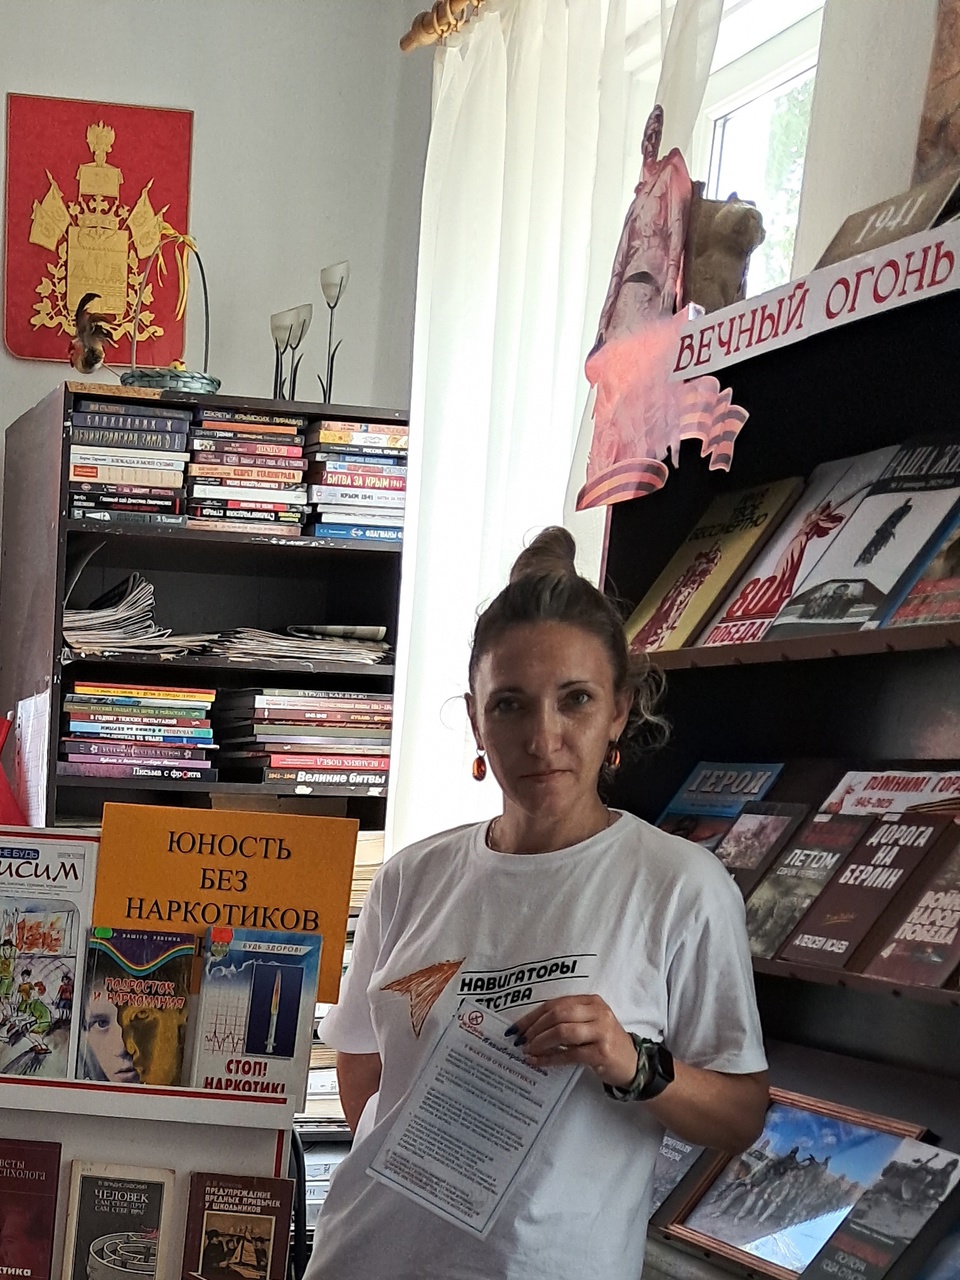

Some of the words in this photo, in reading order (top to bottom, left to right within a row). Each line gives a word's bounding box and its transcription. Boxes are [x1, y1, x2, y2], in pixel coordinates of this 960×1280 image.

[672, 280, 810, 374] ВЕЧНЫЙ
[825, 240, 956, 321] ОГОНЬ
[326, 473, 352, 486] БИТВА
[353, 475, 364, 487] ЗА
[364, 476, 389, 489] КРЫМ
[703, 620, 774, 647] ПОБЕДА!
[132, 766, 162, 777] Письма
[170, 769, 202, 779] фронта
[296, 770, 347, 783] Великие
[348, 772, 386, 784] битвы
[687, 768, 772, 794] ГЕРОИ
[862, 774, 931, 794] ПОМНИМ!
[167, 829, 292, 860] ЮНОСТЬ
[865, 823, 935, 848] ДОРОГА
[0, 849, 12, 858] НЕ
[12, 849, 38, 860] БУДЬ
[784, 848, 842, 870] ЛЕТОМ
[870, 845, 900, 867] НА
[199, 867, 248, 893] БЕЗ
[838, 863, 905, 890] БЕРЛИН
[125, 896, 320, 932] НАРКОТИКОВ
[893, 921, 959, 945] ПОБЕДА
[242, 942, 263, 951] БУДЬ
[266, 944, 303, 954] ЗДОРОВ!
[459, 959, 579, 993] НАВИГАТОРЫ
[105, 977, 175, 996] ПОДРОСТОК
[93, 991, 102, 1001] И
[106, 991, 186, 1010] НАРКОМАНИЯ
[225, 1058, 269, 1078] СТОП!
[94, 1188, 149, 1204] ЧЕЛОВЕК
[204, 1194, 240, 1204] ВРЕДНЫХ
[242, 1197, 281, 1208] ПРИВЫЧЕК
[205, 1186, 272, 1200] ПРЕДУПРЕЖДЕНИЕ
[204, 1201, 210, 1209] У
[212, 1202, 262, 1214] ШКОЛЬНИКОВ
